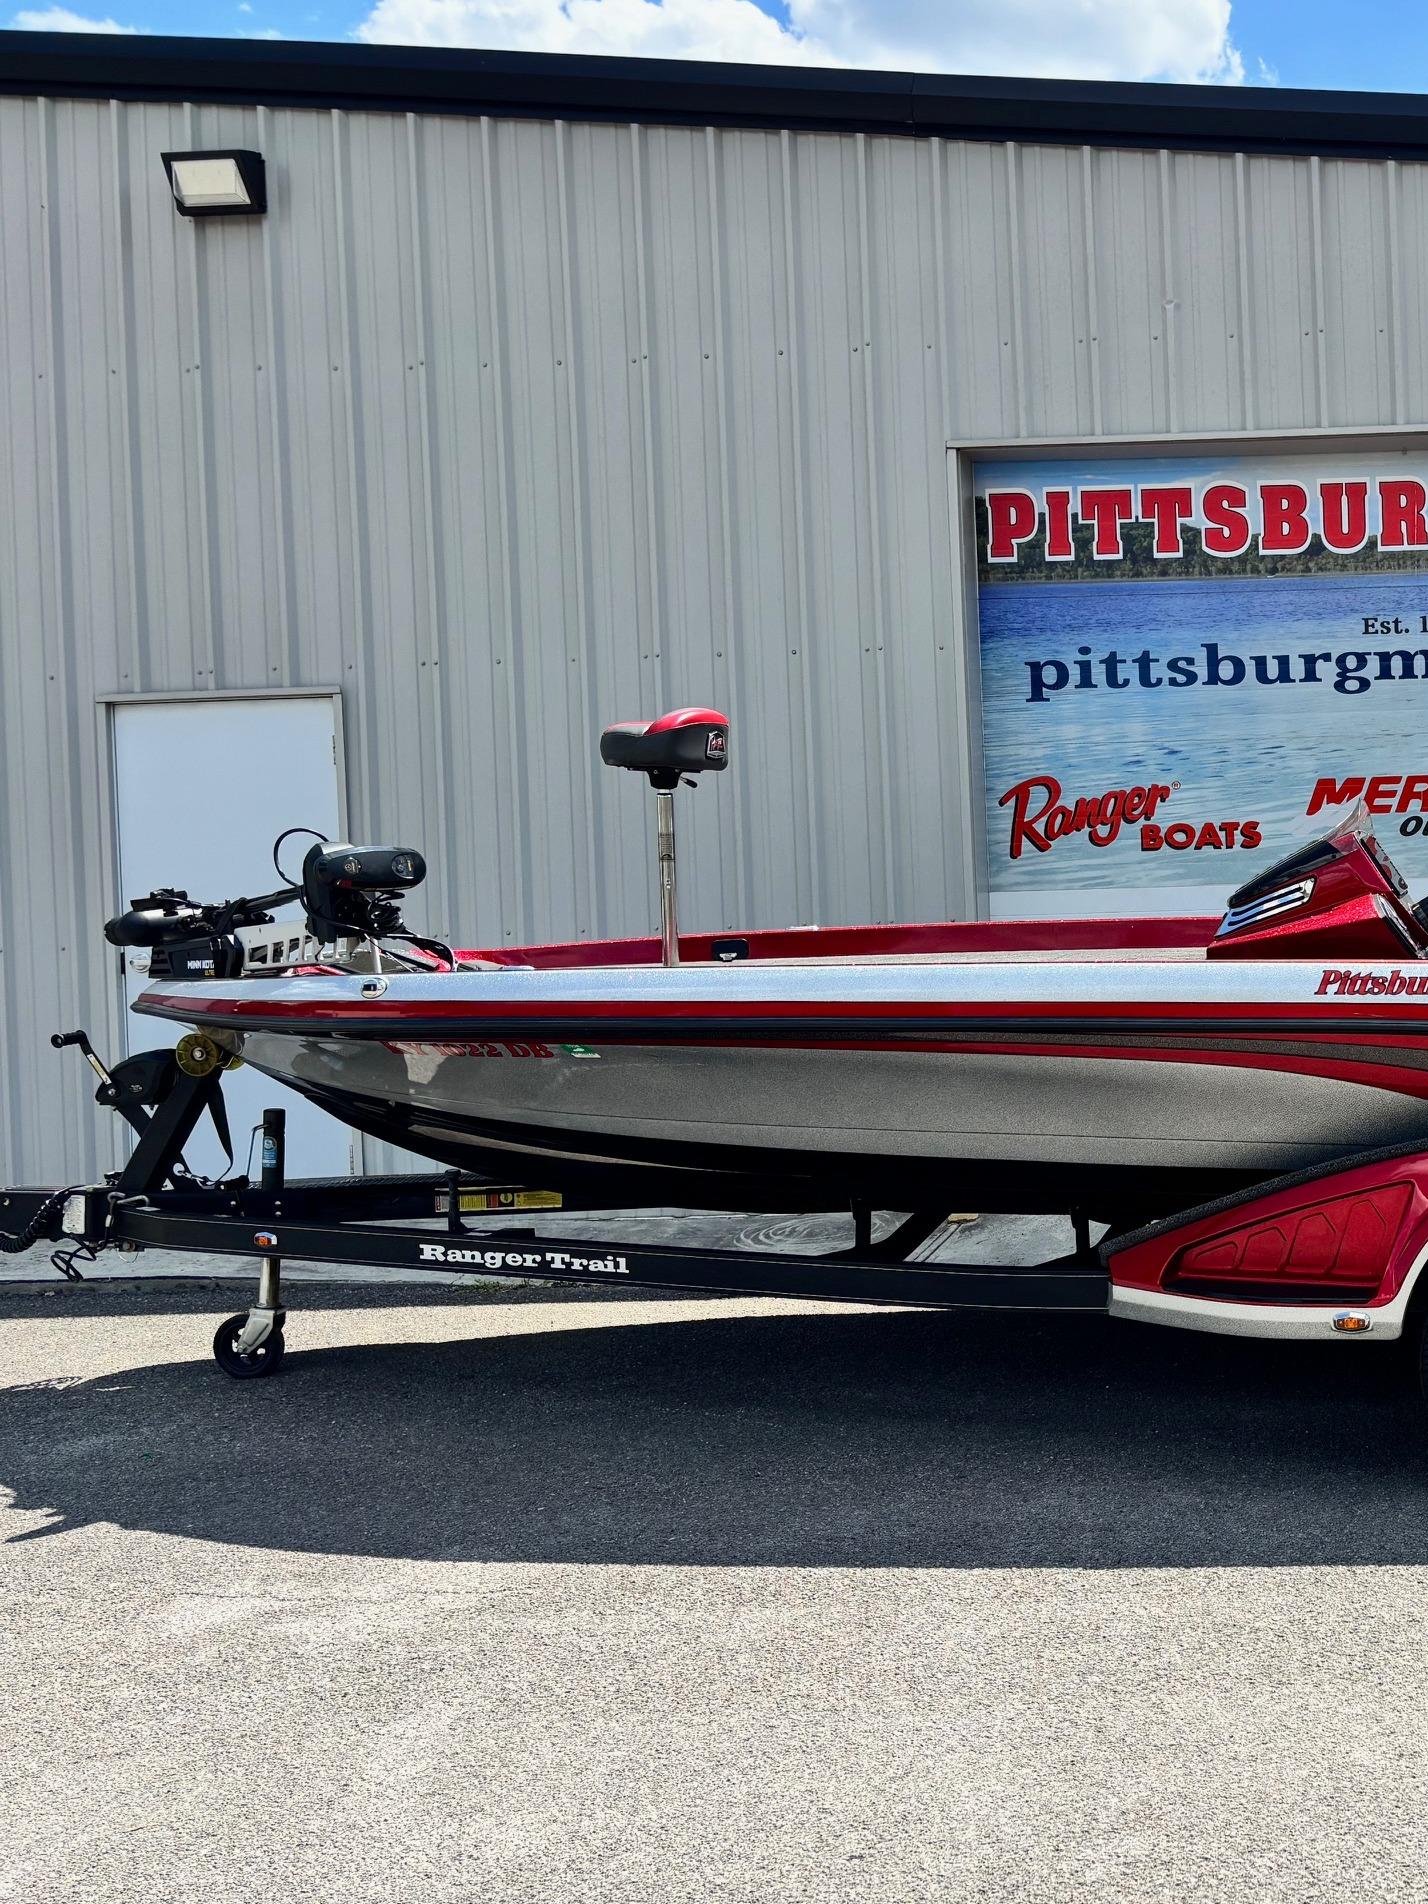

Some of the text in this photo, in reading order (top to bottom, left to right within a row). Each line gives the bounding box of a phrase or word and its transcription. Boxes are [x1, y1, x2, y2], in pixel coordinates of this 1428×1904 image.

[1362, 616, 1410, 635] Est.
[998, 775, 1171, 859] Ranger
[1141, 821, 1262, 851] BOATS
[419, 1244, 630, 1274] Ranger Trail
